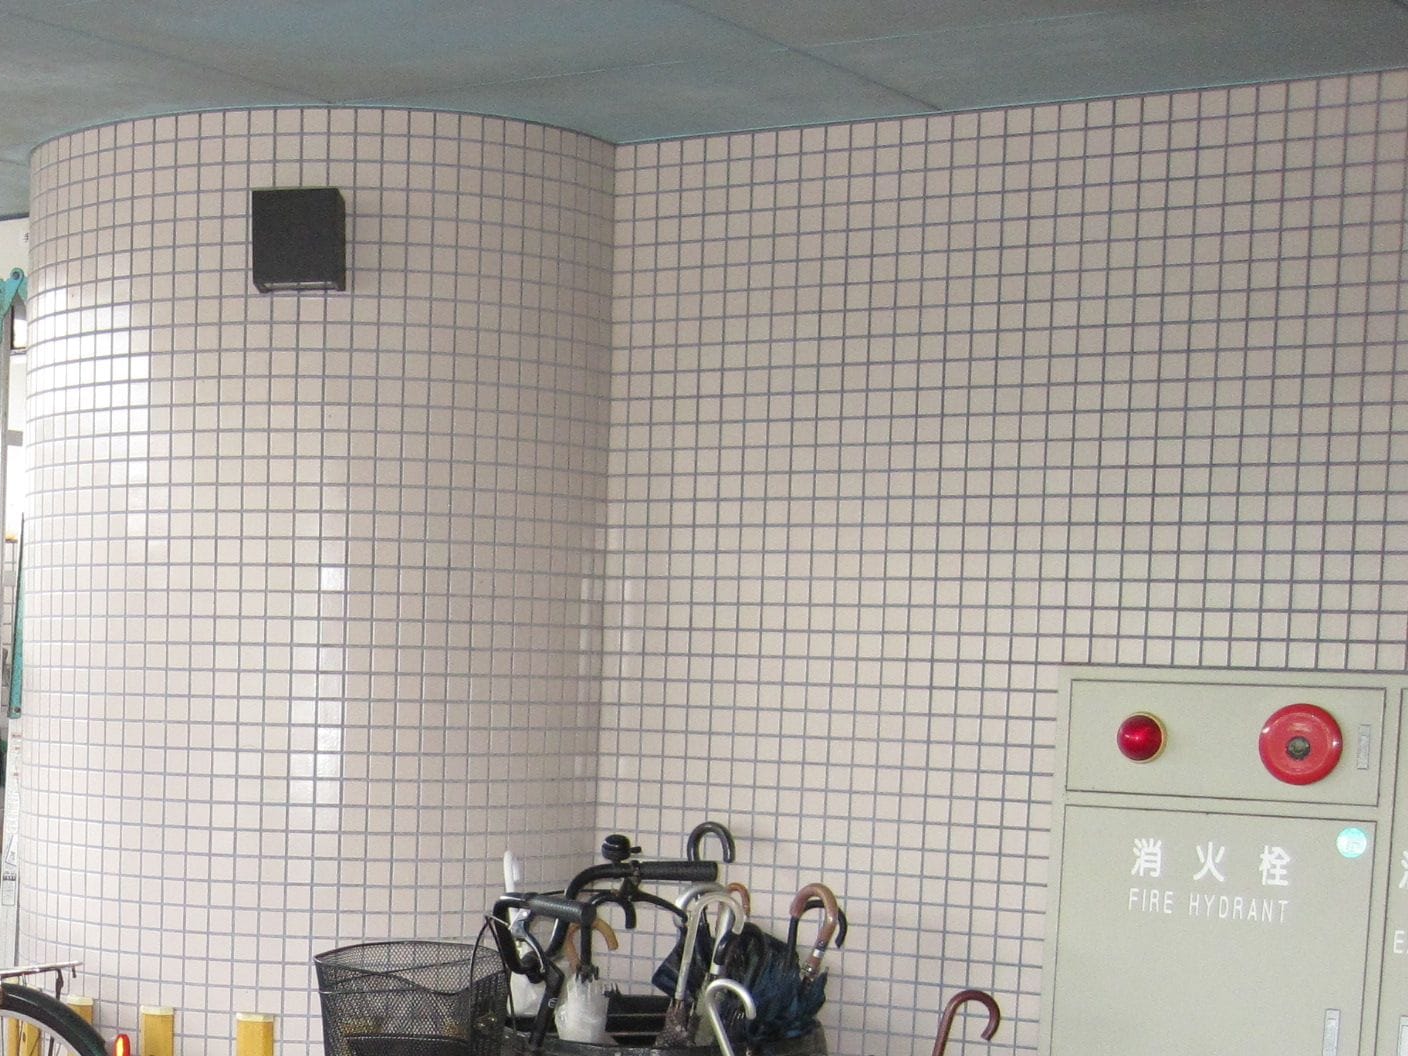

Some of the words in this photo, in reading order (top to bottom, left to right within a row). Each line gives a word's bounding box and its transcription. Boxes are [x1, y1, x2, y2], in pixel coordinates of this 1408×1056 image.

[1130, 838, 1291, 887] 消火栓
[1128, 887, 1174, 914] FIRE
[1189, 892, 1289, 924] HYDRANT
